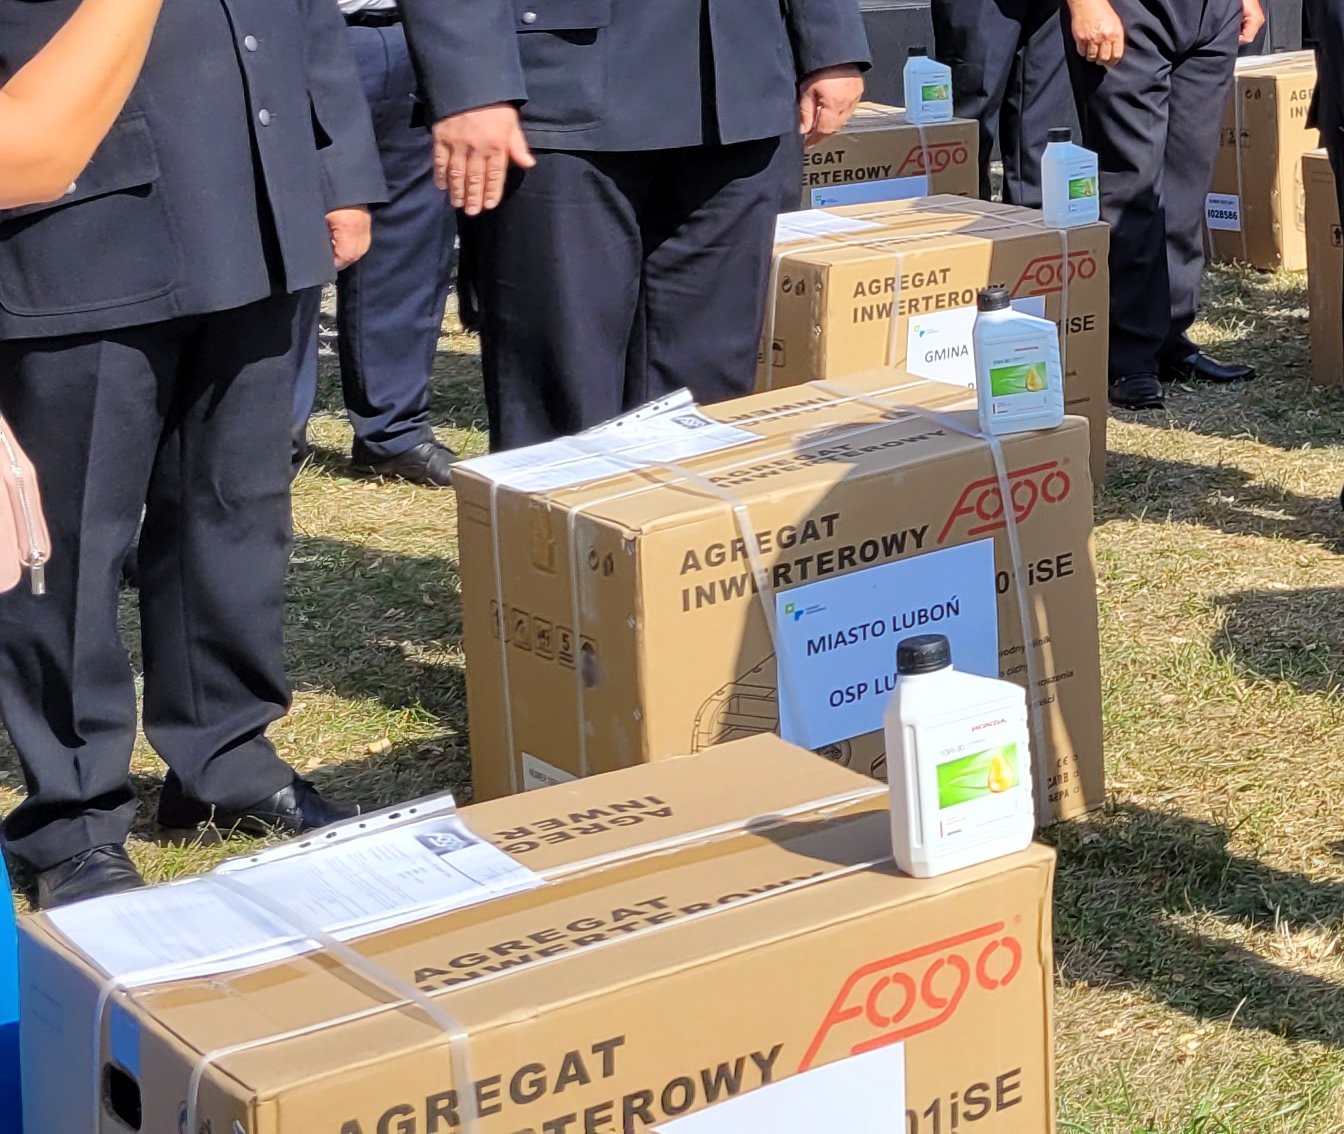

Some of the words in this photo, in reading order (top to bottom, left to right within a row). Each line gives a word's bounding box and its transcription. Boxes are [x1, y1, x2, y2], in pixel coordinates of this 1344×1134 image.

[852, 267, 952, 299] AGREGAT
[924, 344, 969, 364] GMINA
[679, 512, 841, 576] AGREGAT
[681, 524, 931, 614] INWERTEROWY
[805, 615, 887, 657] MIASTO
[892, 594, 961, 635] LUBOŃ
[828, 682, 869, 709] OSP
[413, 895, 669, 984] AGREGAT
